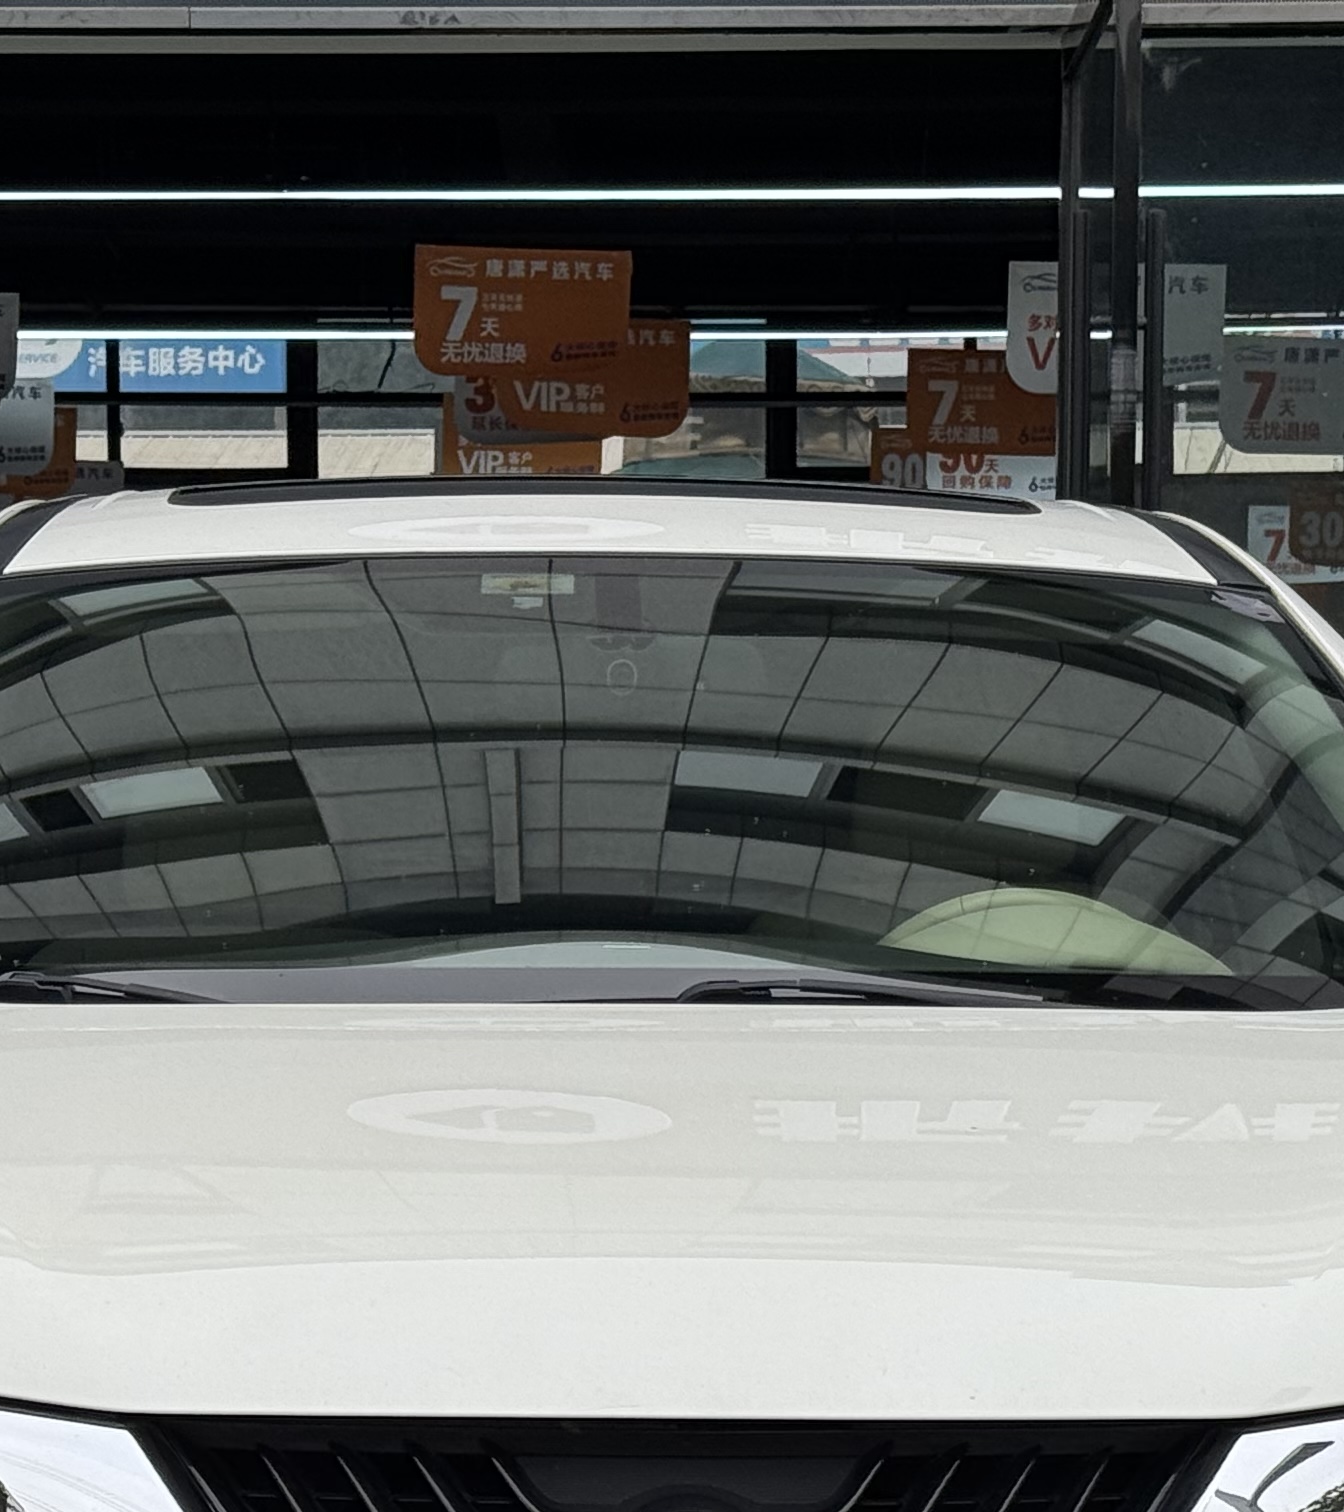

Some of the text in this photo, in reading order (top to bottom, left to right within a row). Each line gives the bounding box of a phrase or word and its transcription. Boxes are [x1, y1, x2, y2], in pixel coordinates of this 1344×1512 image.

[441, 343, 527, 365] 无忧退换
[513, 380, 606, 413] VIP 客户
[928, 427, 998, 445] 无忧退换
[1242, 420, 1321, 441] 无忧退换
[457, 450, 504, 474] VIP
[508, 451, 533, 465] 客户
[942, 475, 1012, 489] 回购保障
